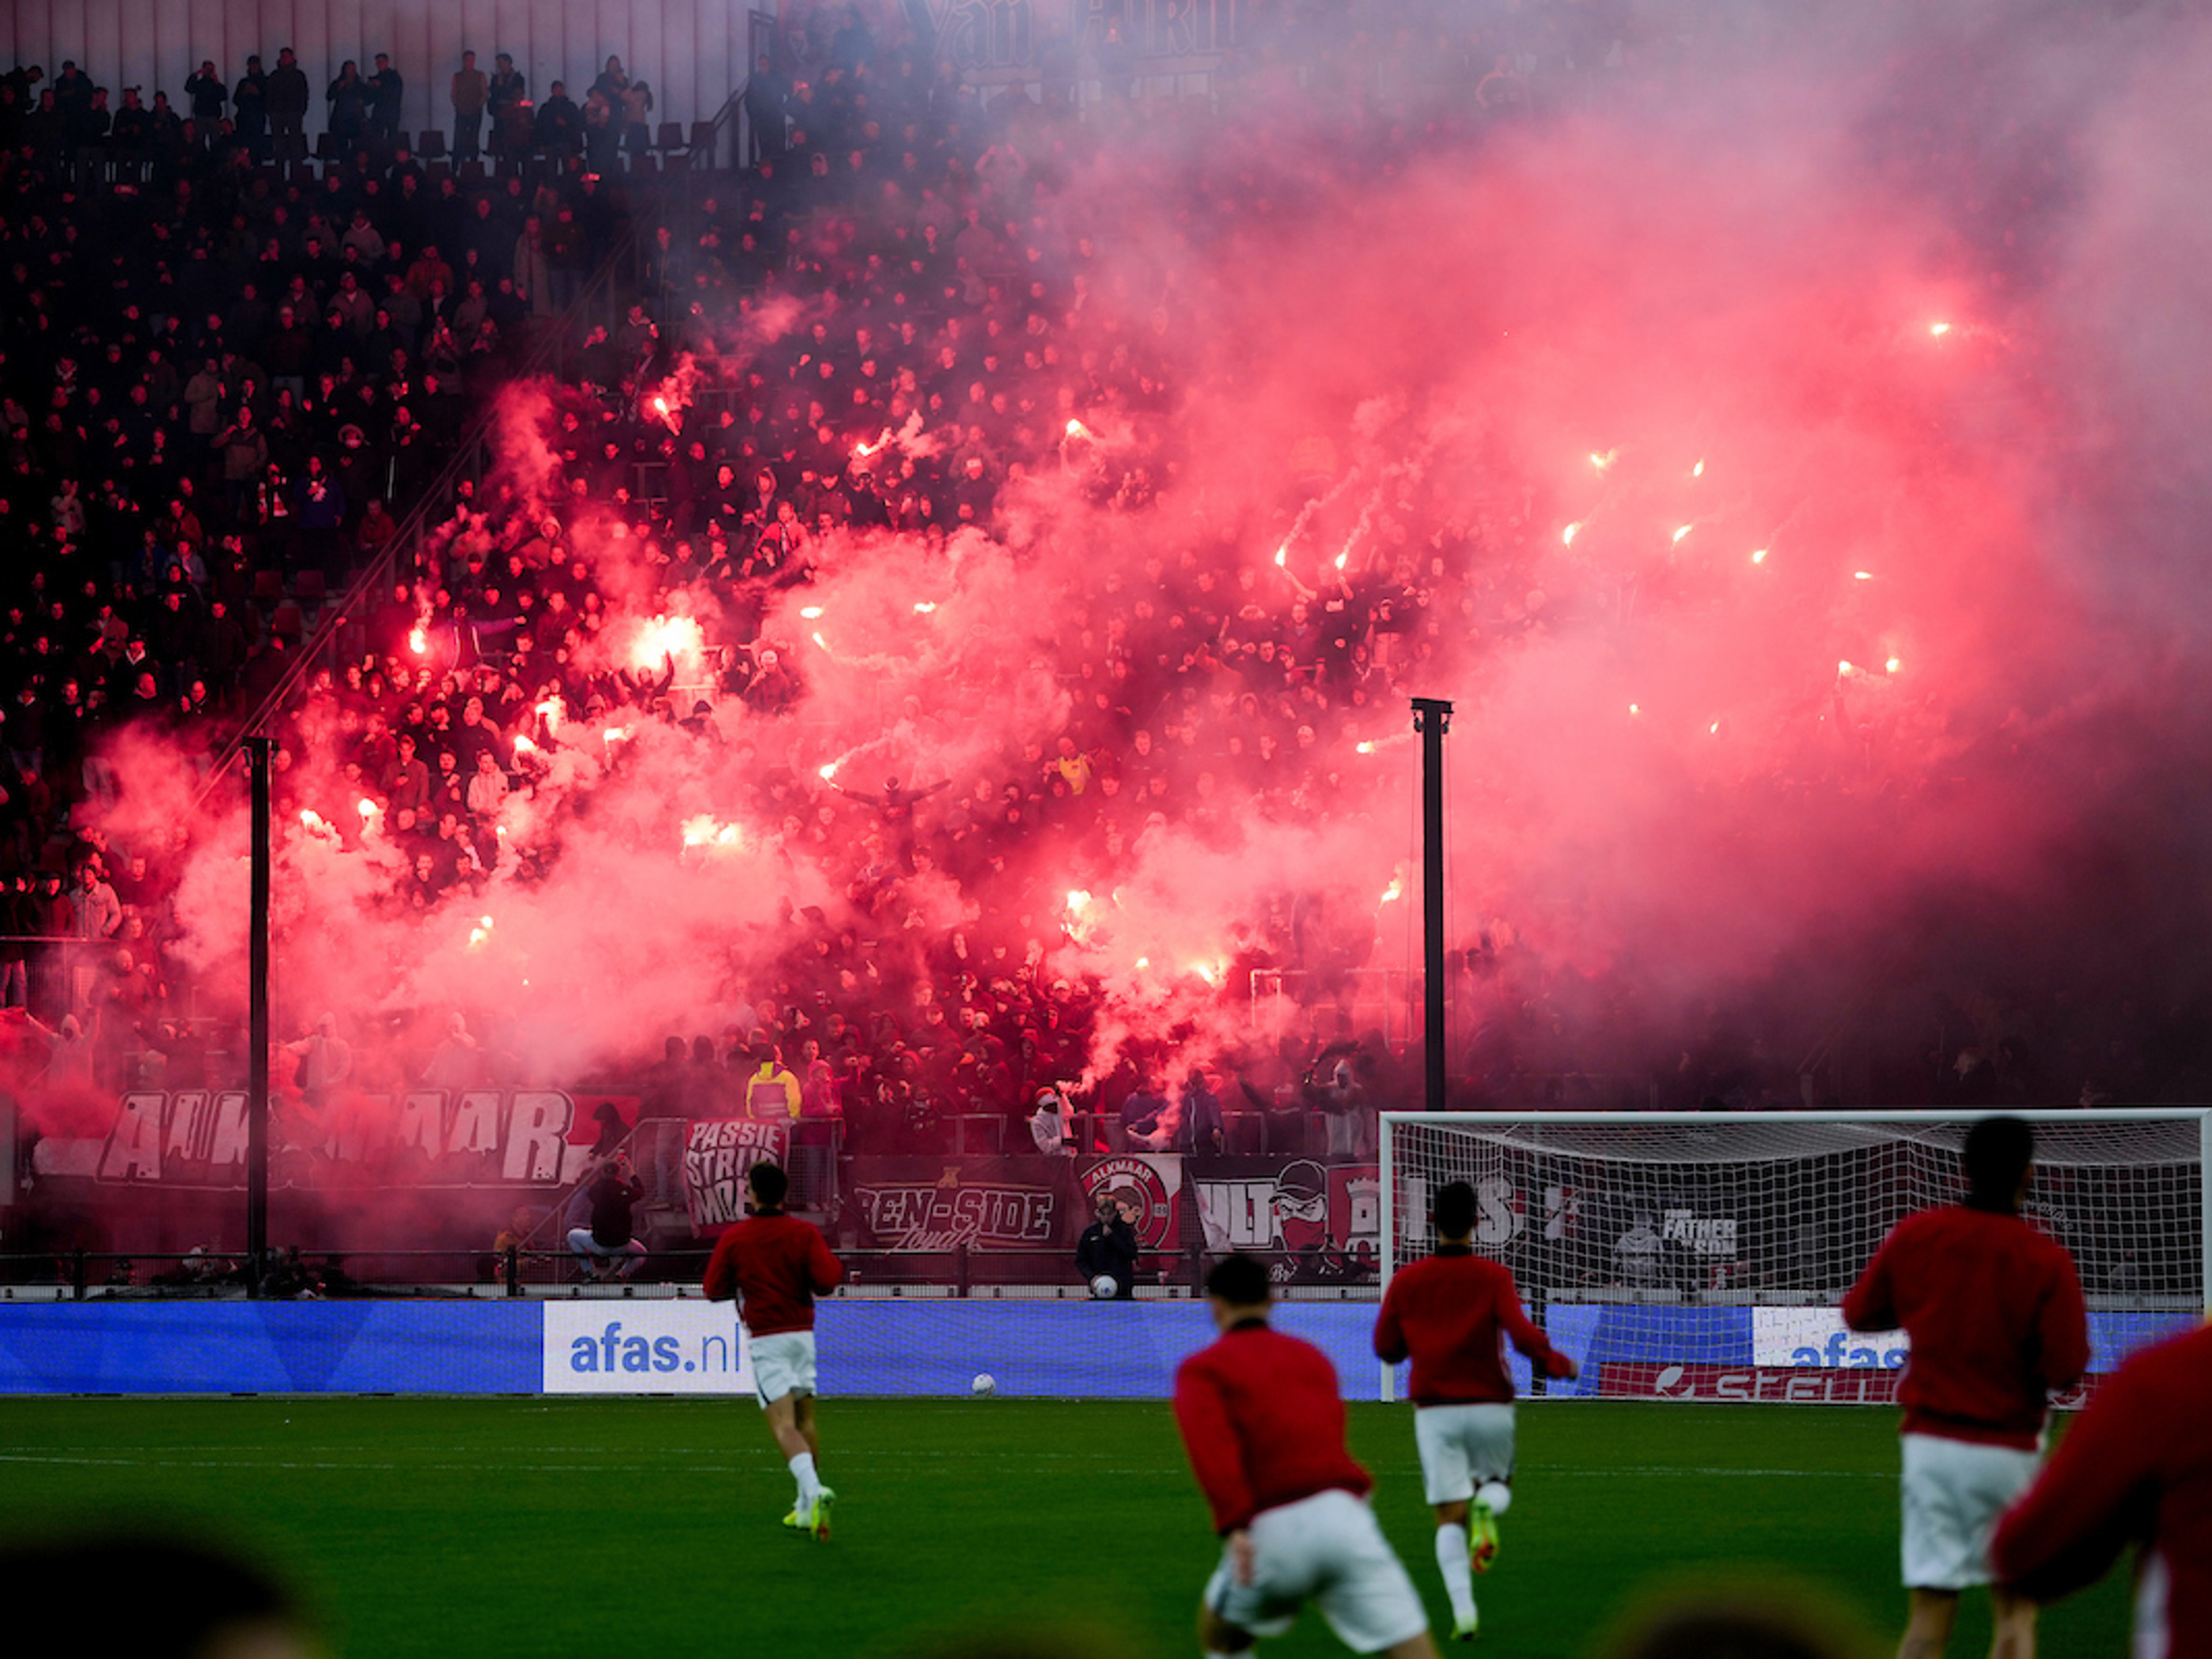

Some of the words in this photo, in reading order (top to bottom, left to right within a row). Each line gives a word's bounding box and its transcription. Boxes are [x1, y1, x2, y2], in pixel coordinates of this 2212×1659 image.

[689, 1121, 781, 1153] PASSIE
[1092, 1160, 1153, 1184] ALKMAAR
[1664, 1218, 1737, 1238] FATHER
[1694, 1239, 1736, 1254] SON
[570, 1320, 740, 1373] afas.nl
